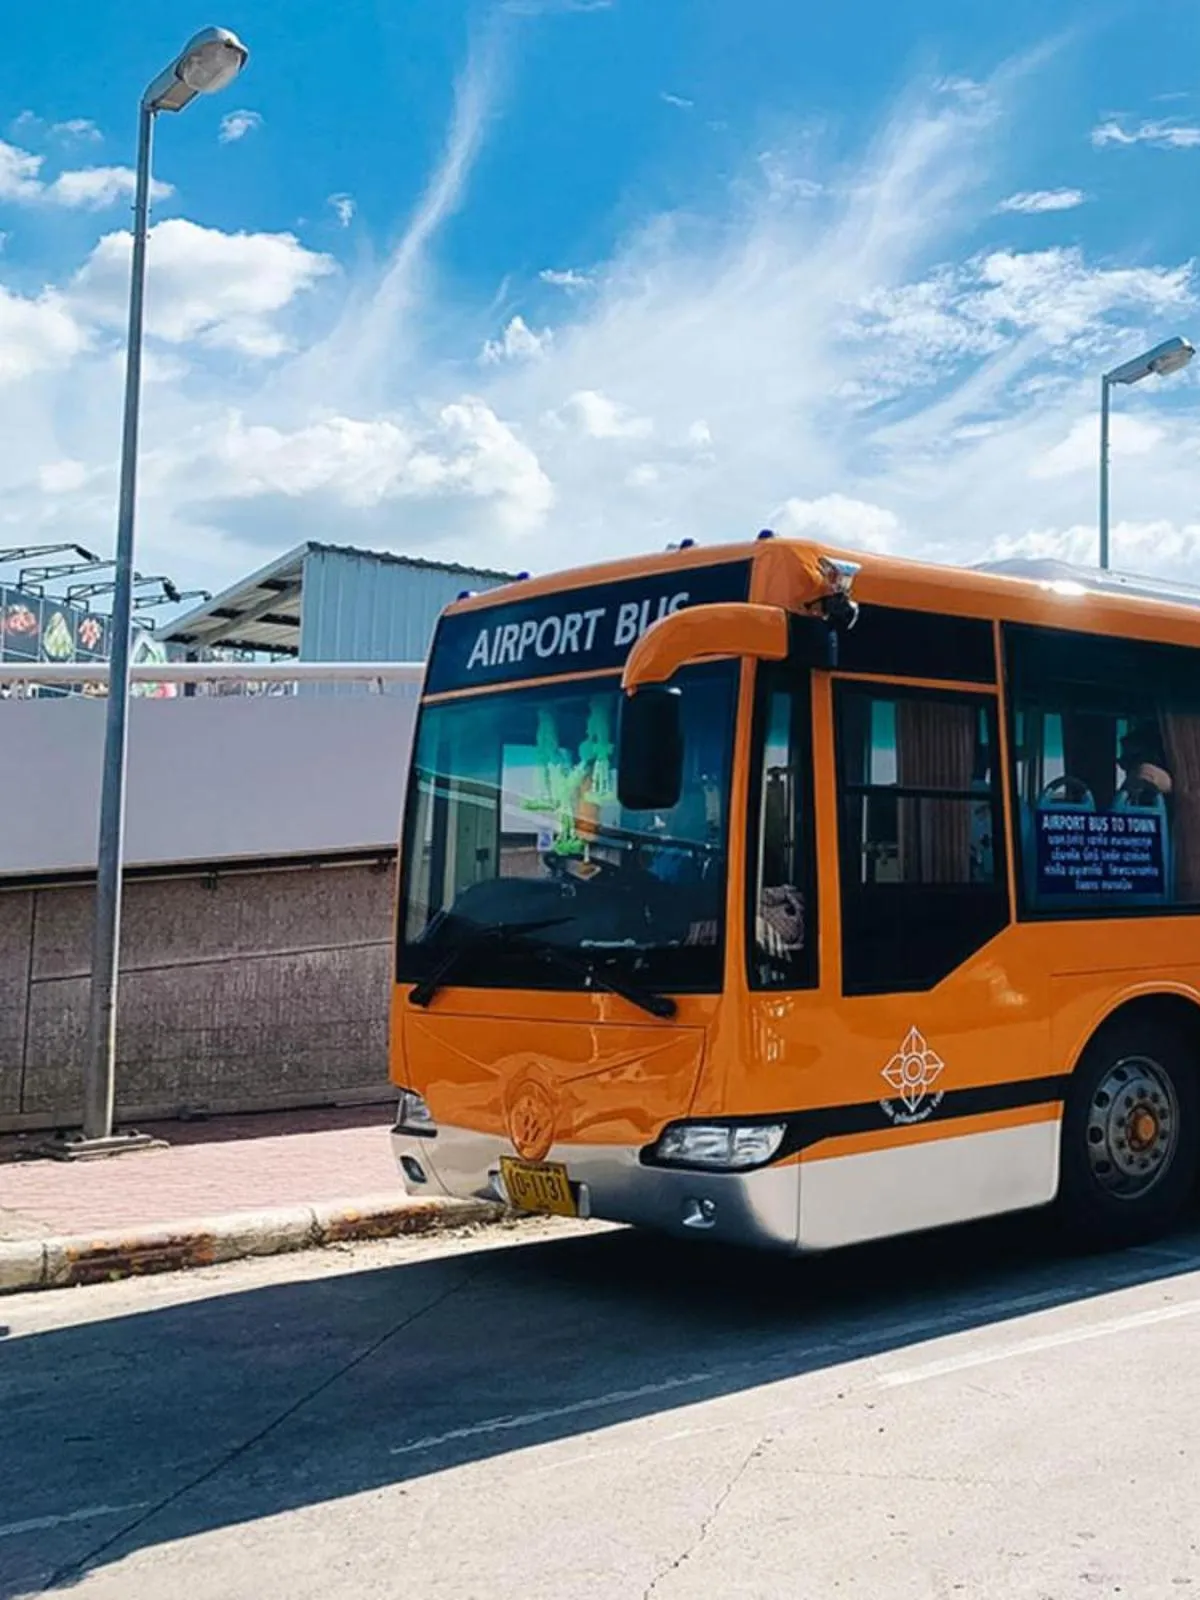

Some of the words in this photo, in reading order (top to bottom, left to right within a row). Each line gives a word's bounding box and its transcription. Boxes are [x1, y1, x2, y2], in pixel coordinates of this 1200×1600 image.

[466, 608, 606, 670] AIRPORT
[1042, 815, 1085, 830] AIRPORT
[1089, 816, 1108, 832] BUS
[1111, 818, 1125, 831] TO
[1127, 818, 1156, 832] TOWN
